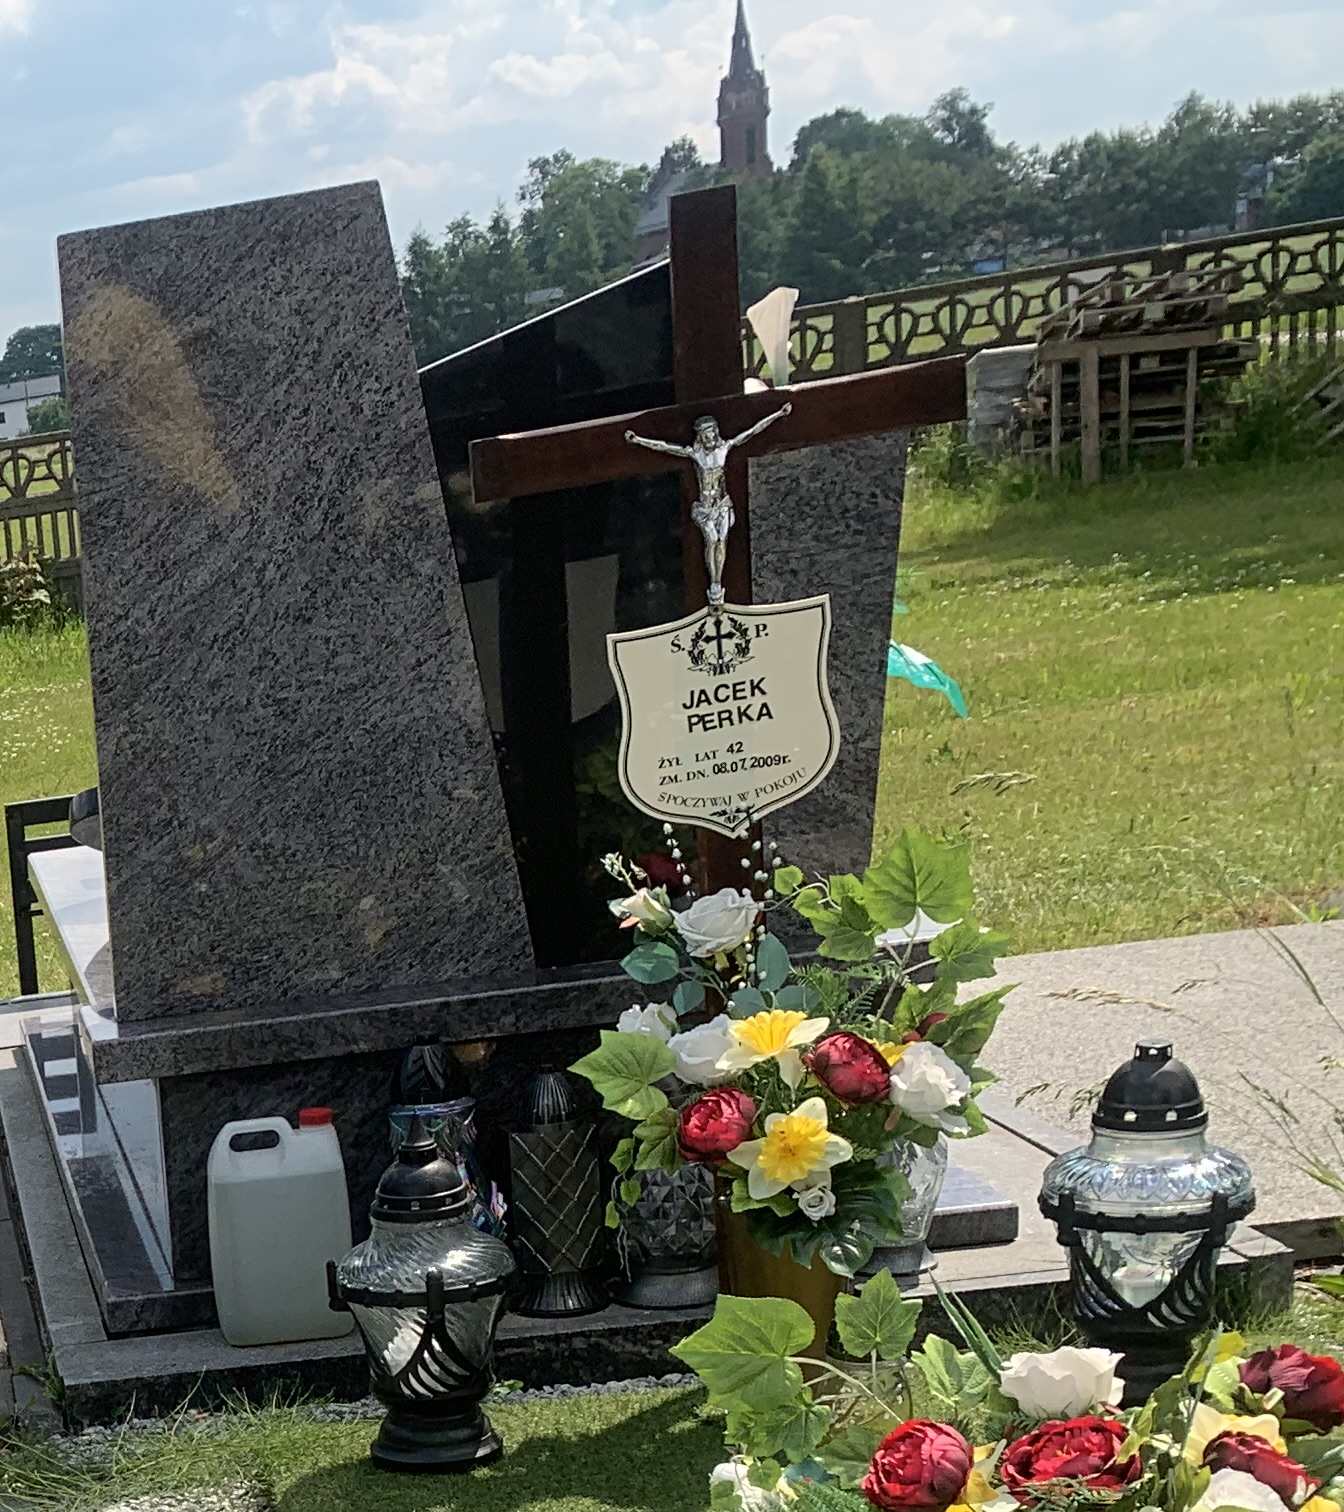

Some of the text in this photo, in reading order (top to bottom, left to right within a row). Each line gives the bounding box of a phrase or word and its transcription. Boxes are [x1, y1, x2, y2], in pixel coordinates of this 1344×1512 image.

[754, 623, 769, 638] P.
[682, 677, 767, 710] JACEK
[687, 702, 774, 733] PERKA
[658, 741, 744, 769] ŻYŁ LAT 42
[657, 767, 808, 808] SPOCZYWAJ W POKOJU
[659, 775, 683, 786] ZM.
[686, 769, 710, 782] DN.
